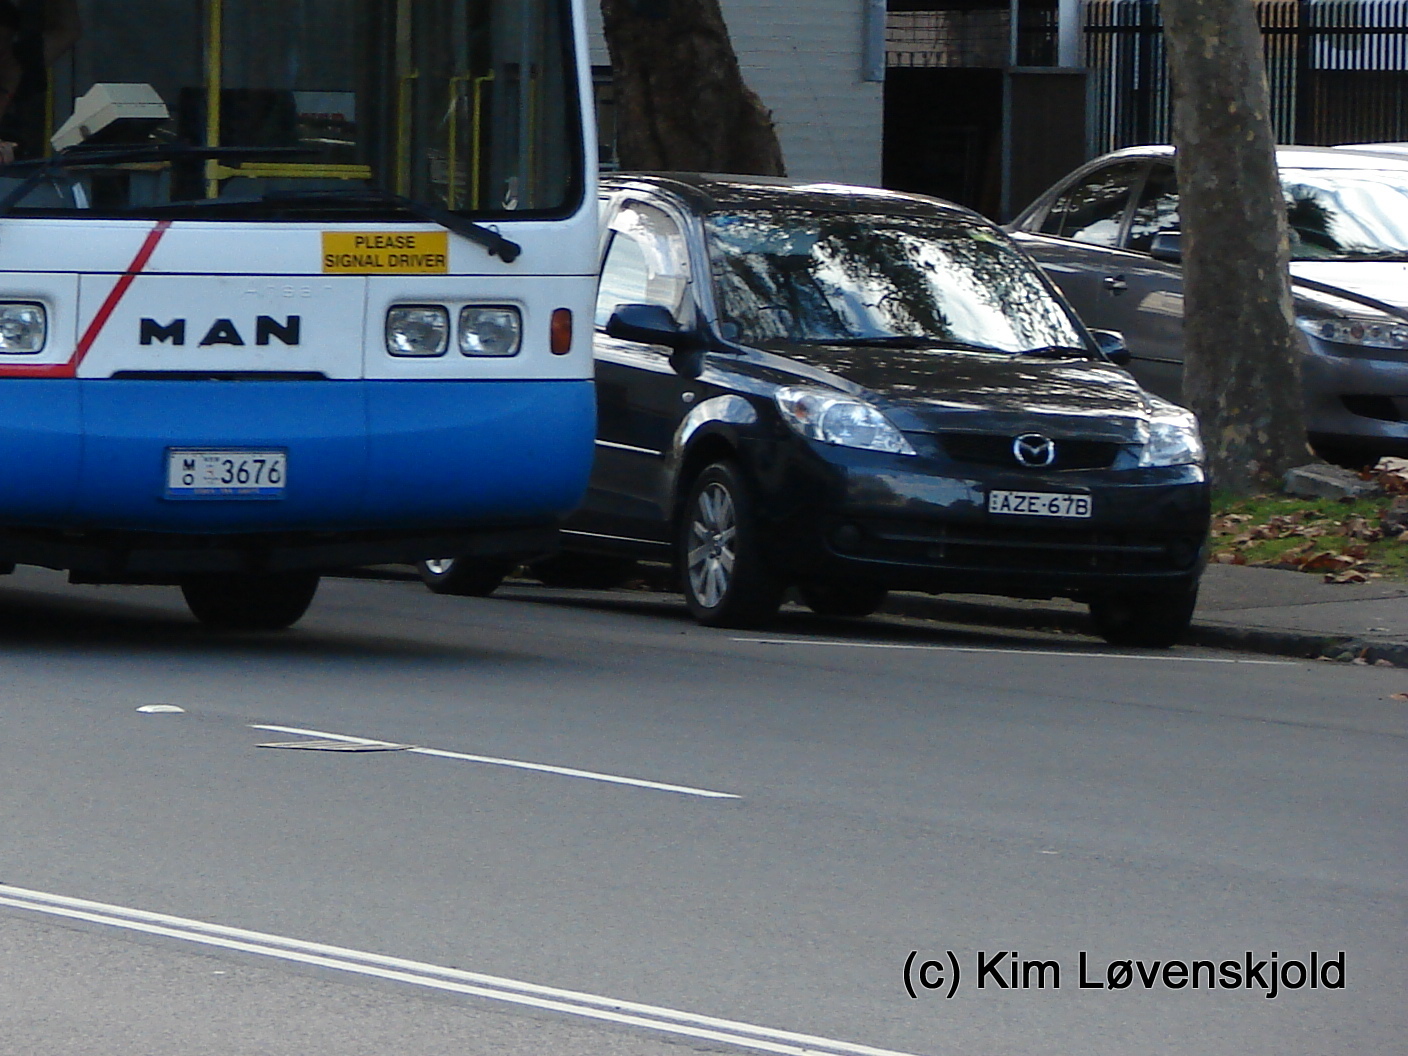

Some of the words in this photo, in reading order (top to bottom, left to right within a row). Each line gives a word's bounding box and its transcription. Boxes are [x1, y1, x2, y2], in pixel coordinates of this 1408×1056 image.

[355, 236, 416, 249] PLEASE
[325, 254, 382, 268] SIGNAL
[387, 254, 446, 268] DRIVER
[139, 315, 301, 347] MAN
[220, 459, 282, 484] 3676
